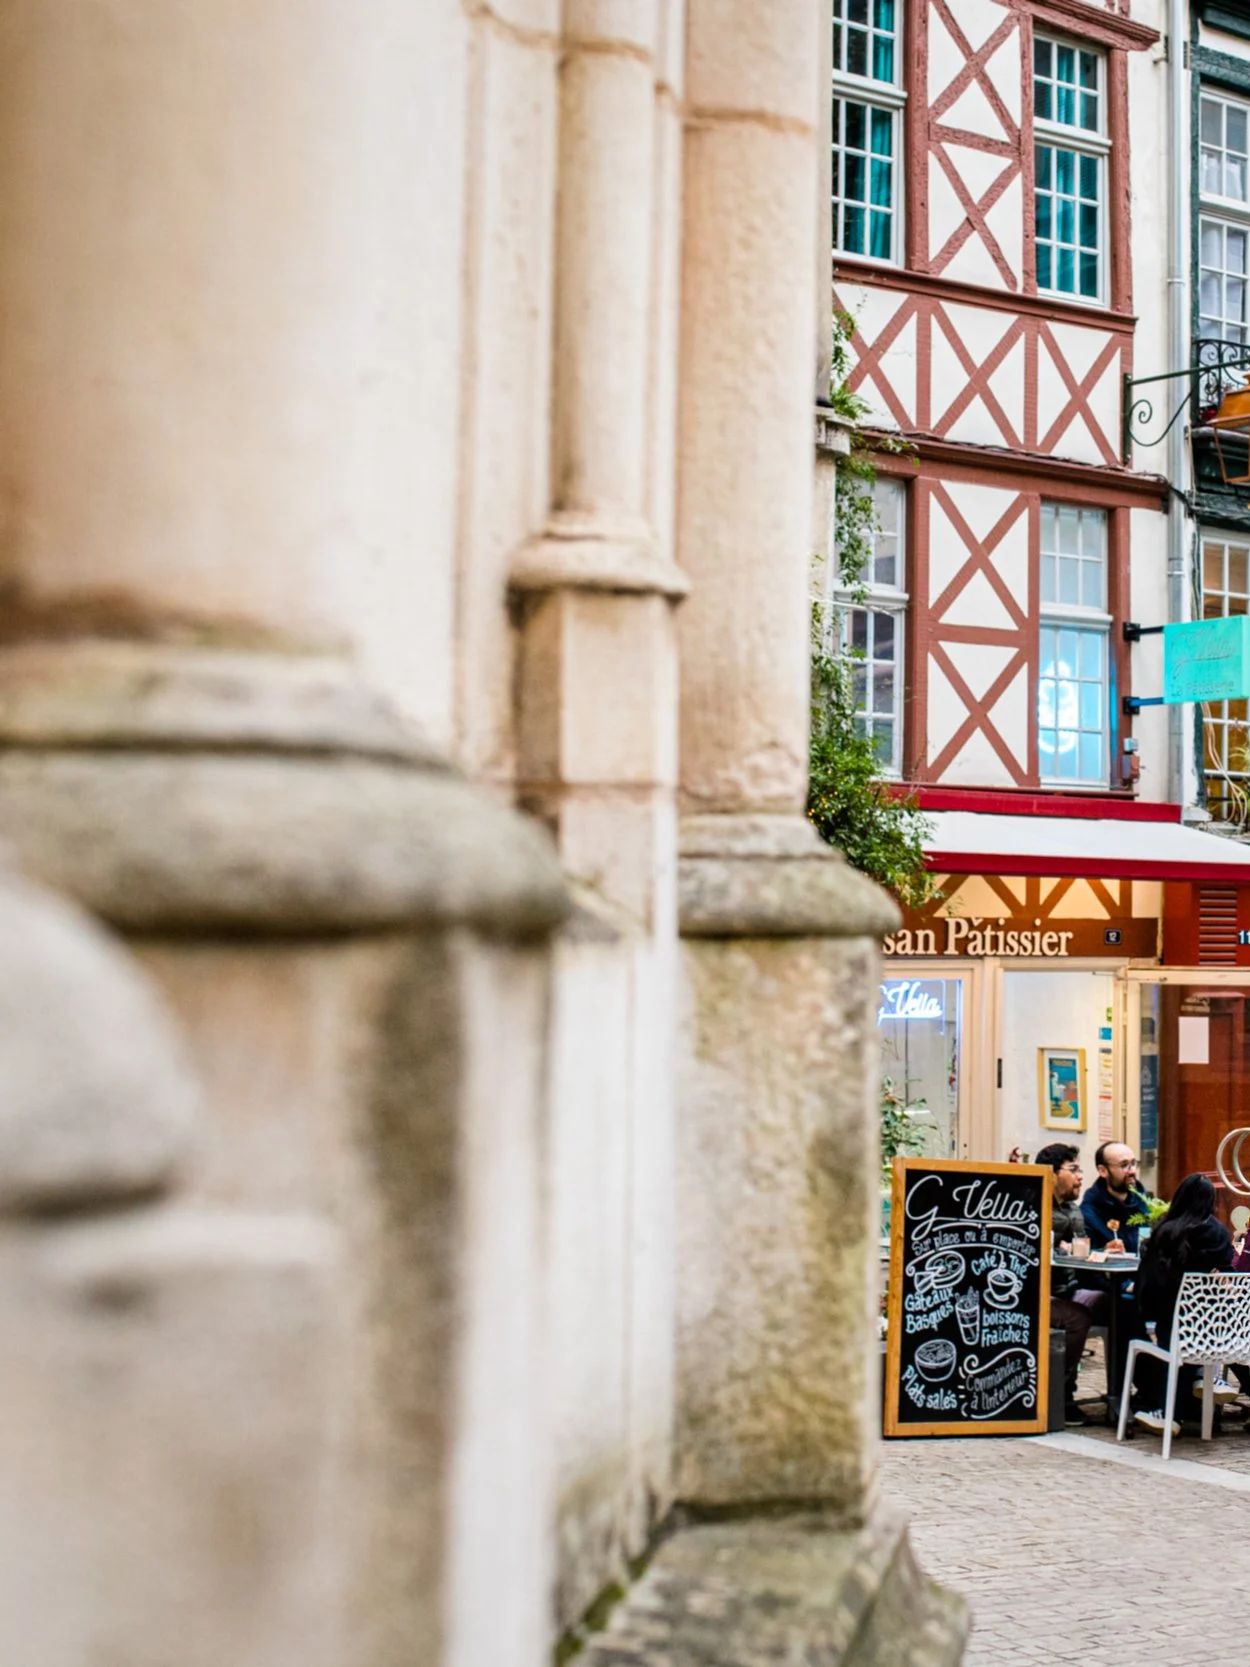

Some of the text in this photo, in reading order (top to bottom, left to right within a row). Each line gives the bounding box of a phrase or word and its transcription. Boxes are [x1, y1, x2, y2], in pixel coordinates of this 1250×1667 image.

[882, 929, 938, 955] san
[952, 1180, 1029, 1220] Vella
[933, 1230, 960, 1251] place
[964, 1231, 977, 1243] ou
[992, 1232, 1037, 1257] emporter
[1009, 1254, 1030, 1279] Thé
[905, 1301, 954, 1334] Basques
[901, 1364, 958, 1410] Plats salés
[965, 1358, 1024, 1391] Commandez
